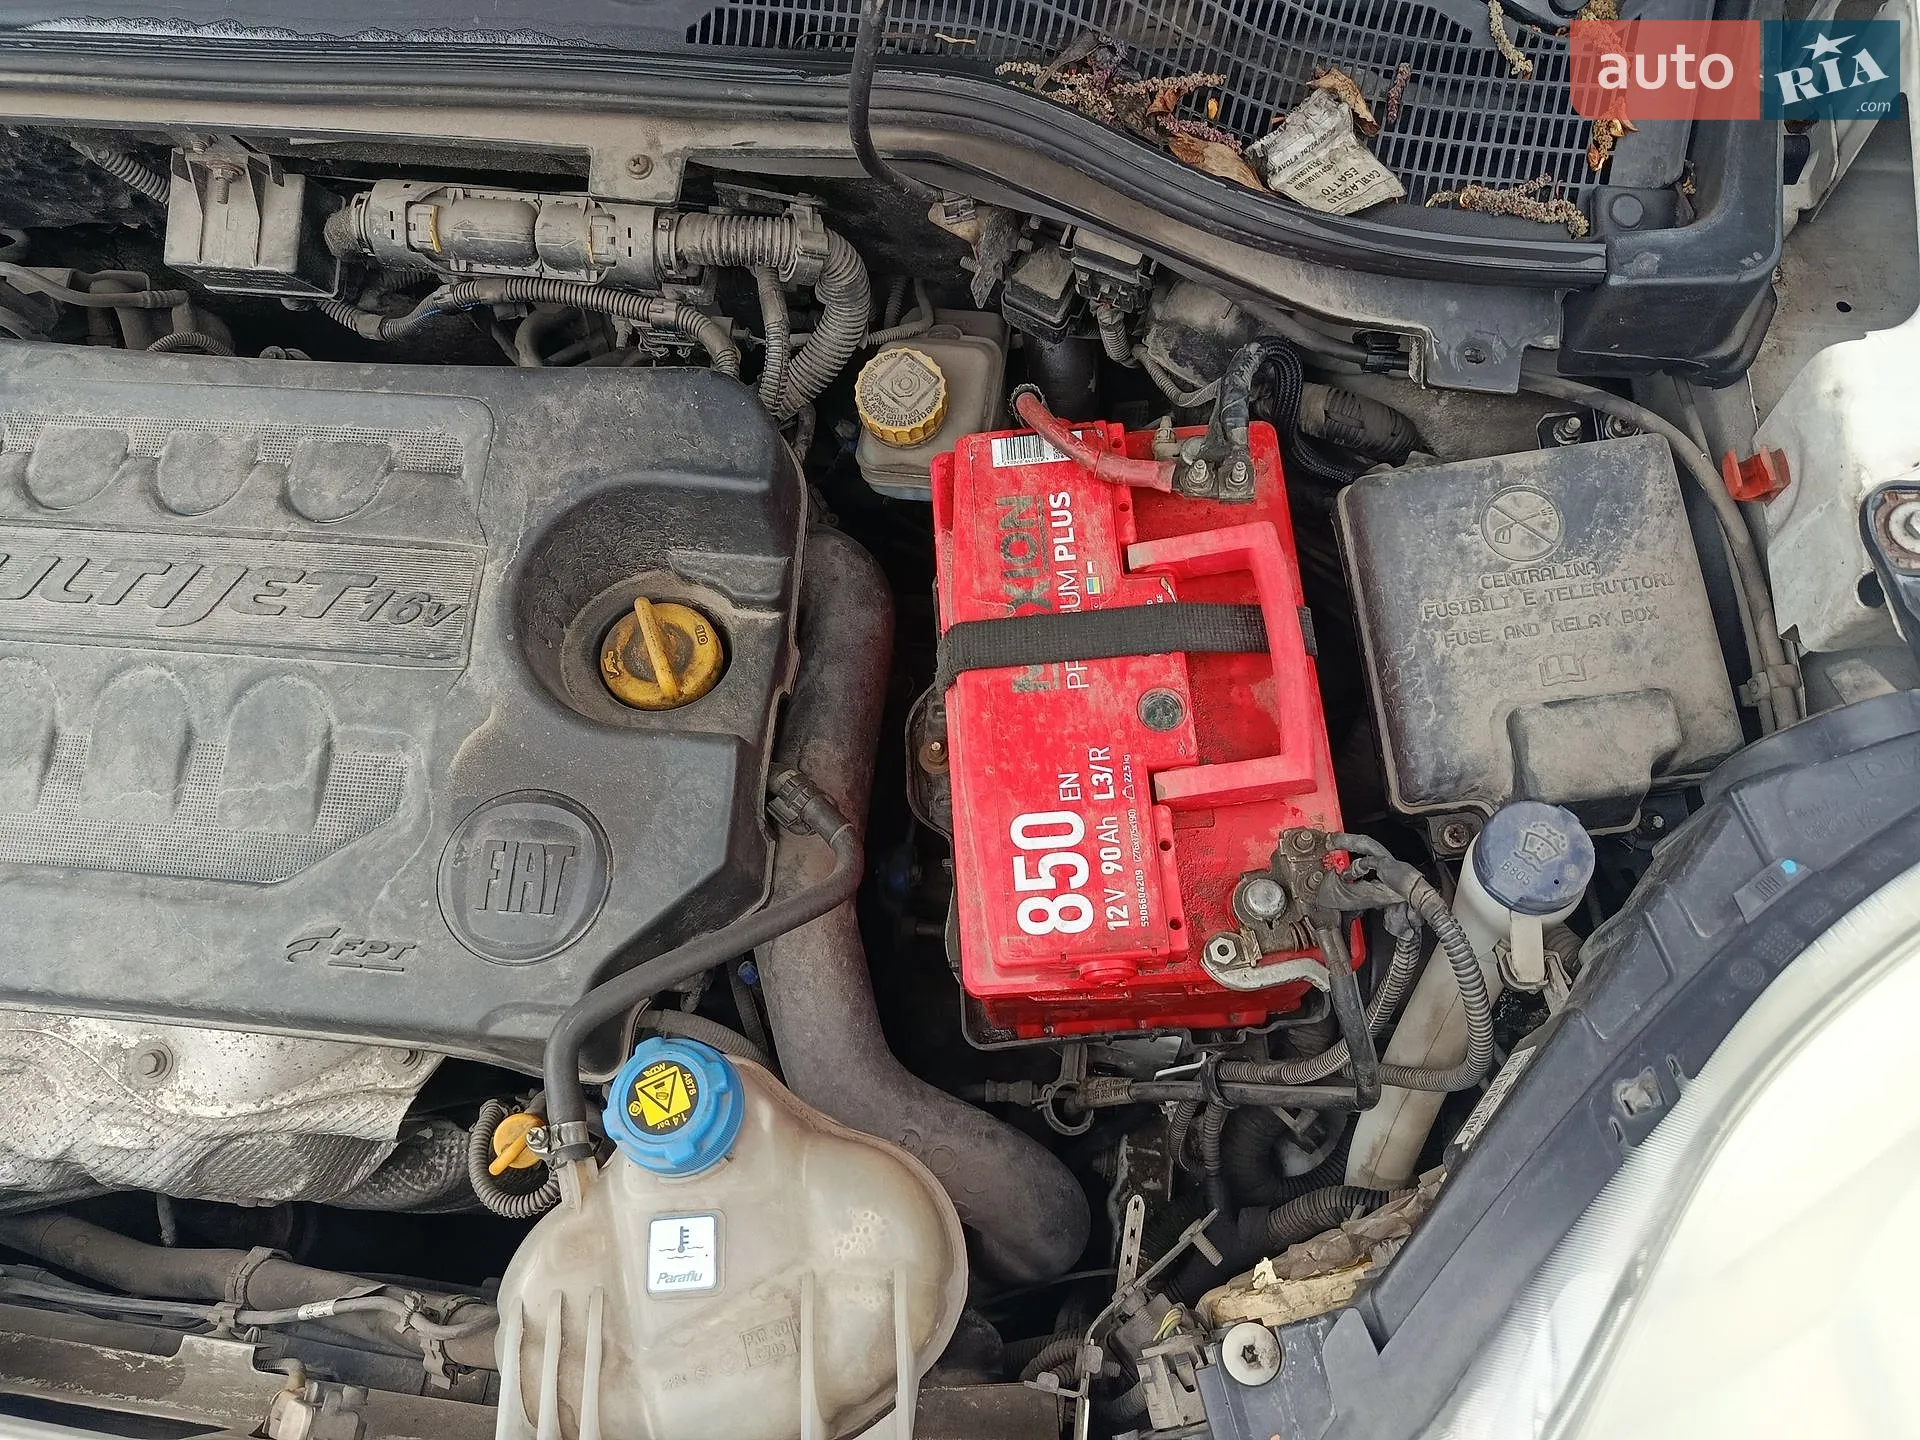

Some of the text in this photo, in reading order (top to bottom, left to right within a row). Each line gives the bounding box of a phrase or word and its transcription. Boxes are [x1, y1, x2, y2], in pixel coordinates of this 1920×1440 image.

[1321, 167, 1359, 196] ESATTO
[1049, 491, 1077, 562] PLUS
[996, 495, 1051, 693] MXION
[1423, 573, 1675, 620] FUSIBILI E TELERUTTORI
[1480, 561, 1600, 590] CENTRALINA
[1444, 605, 1660, 649] FUSE AND RELAY BOX
[1088, 746, 1115, 800] L3/R
[474, 839, 575, 915] FIAT
[1009, 772, 1094, 935] 850 EN
[1135, 869, 1149, 927] 5906604209
[331, 938, 417, 960] FPT
[656, 1112, 688, 1130] 1.4 bar
[657, 1270, 703, 1285] Paraflu
